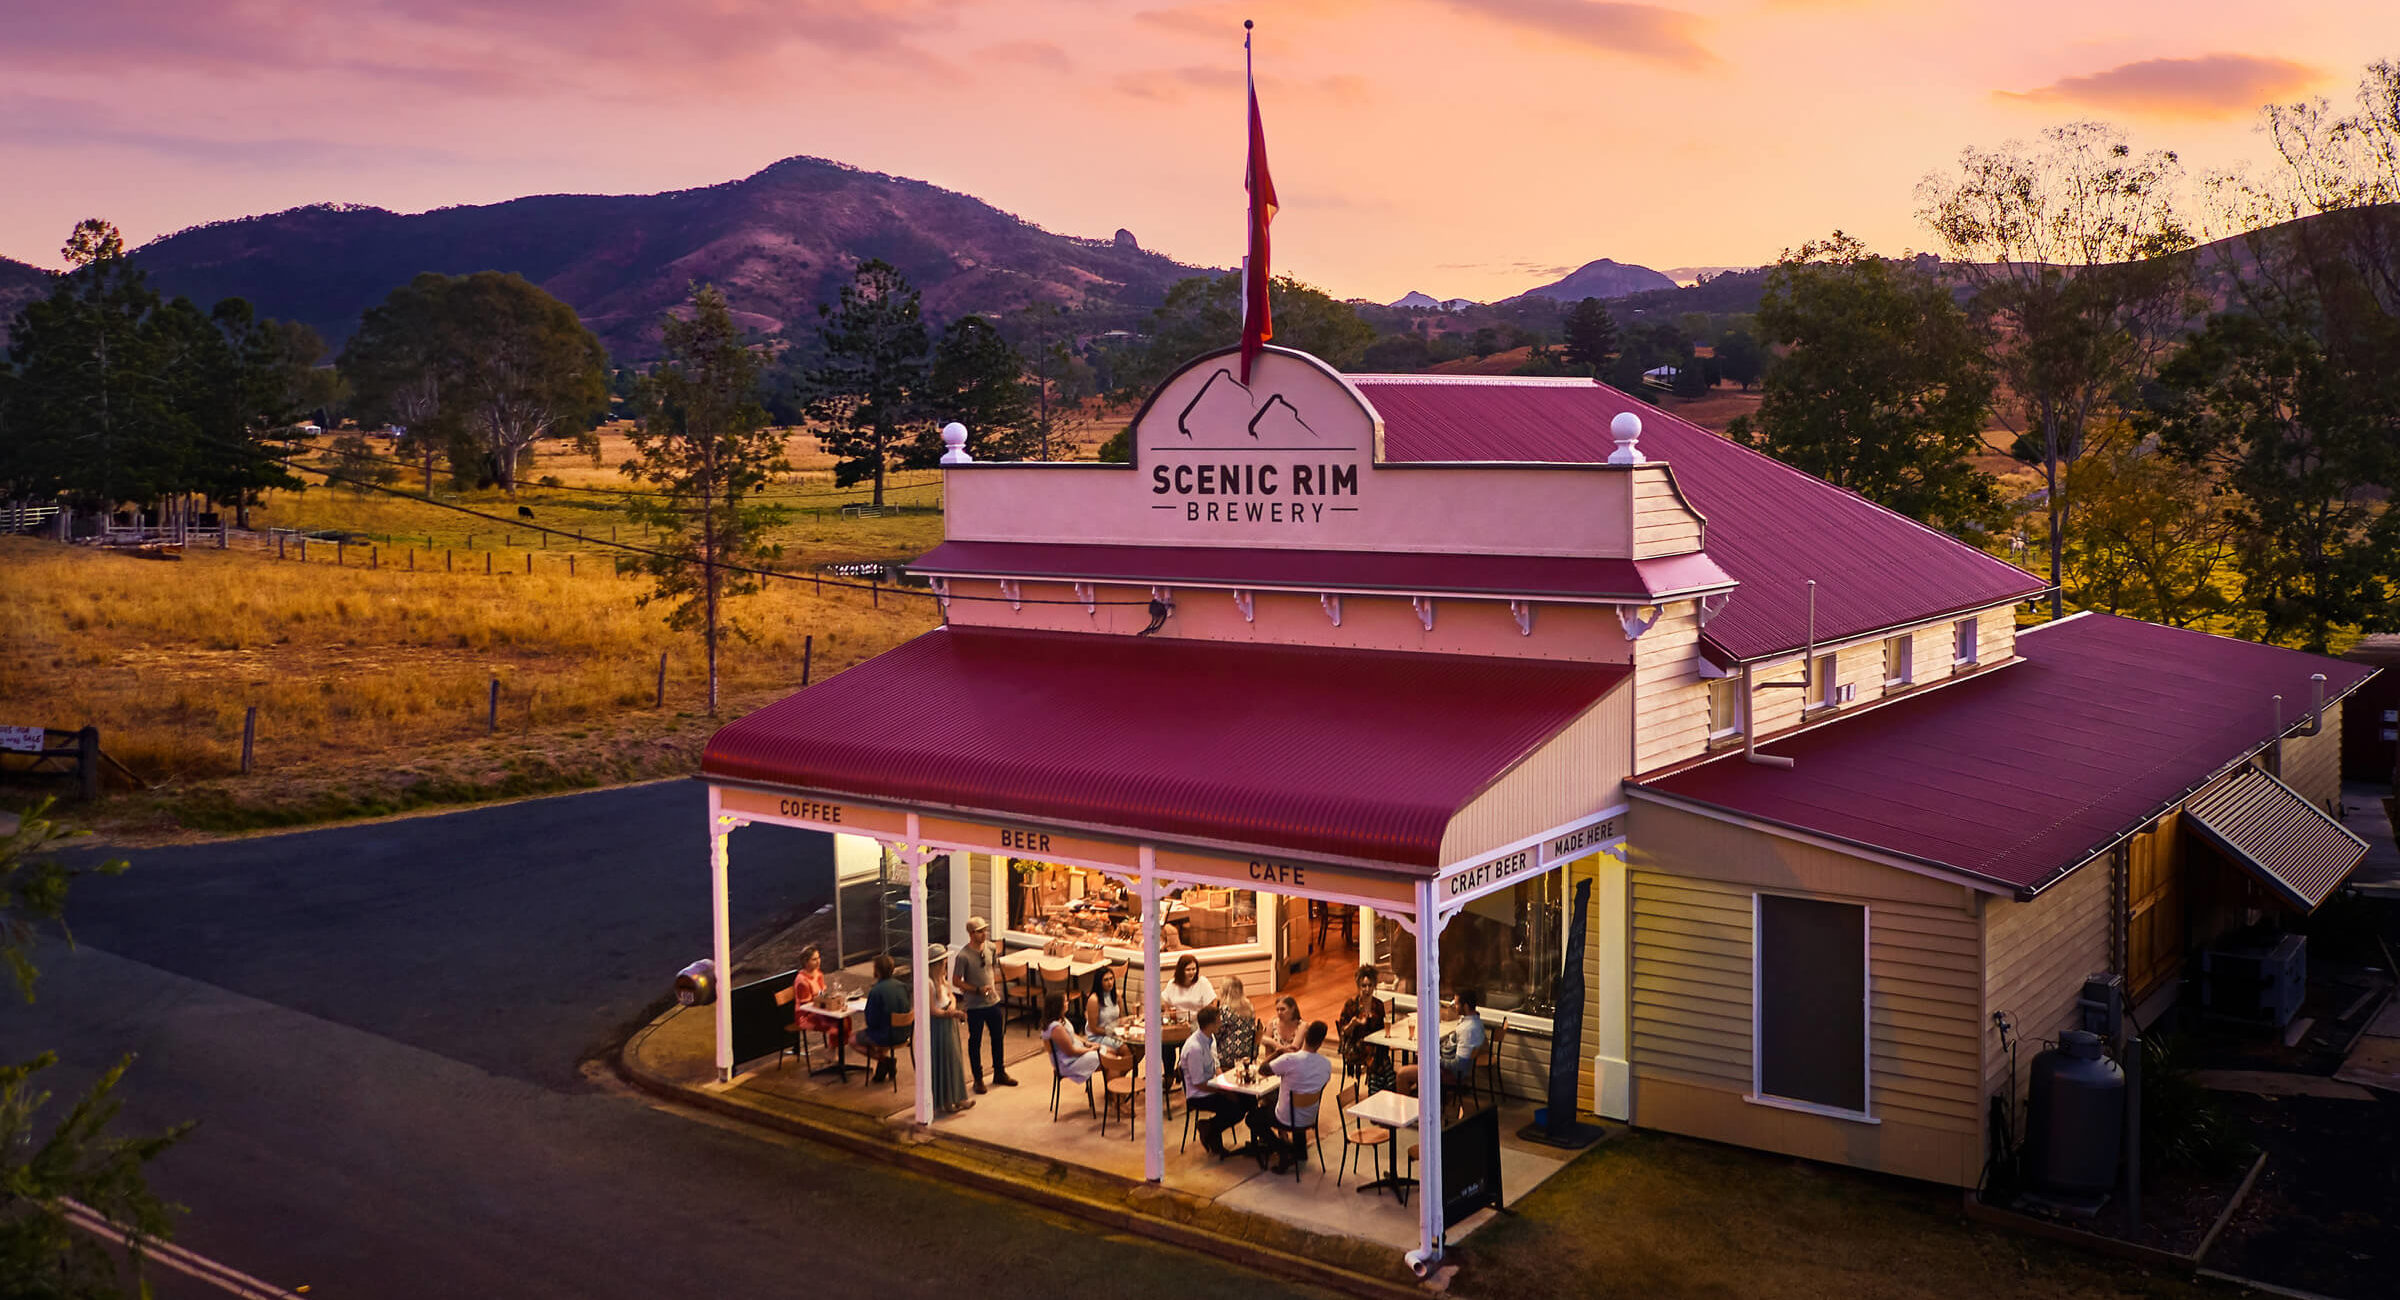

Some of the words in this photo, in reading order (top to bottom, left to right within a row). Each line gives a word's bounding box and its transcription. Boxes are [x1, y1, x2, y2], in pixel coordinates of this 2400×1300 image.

[1153, 464, 1278, 495] SCENIC
[1293, 464, 1358, 495] RIM
[1187, 502, 1323, 523] BREWERY
[780, 799, 842, 823] COFFEE
[1001, 829, 1050, 852] BEER
[1554, 834, 1584, 857] MADE
[1586, 821, 1614, 846] HERE
[1249, 861, 1305, 886] CAFE
[1450, 865, 1491, 895] CRAFT
[1495, 852, 1527, 879] BEER
